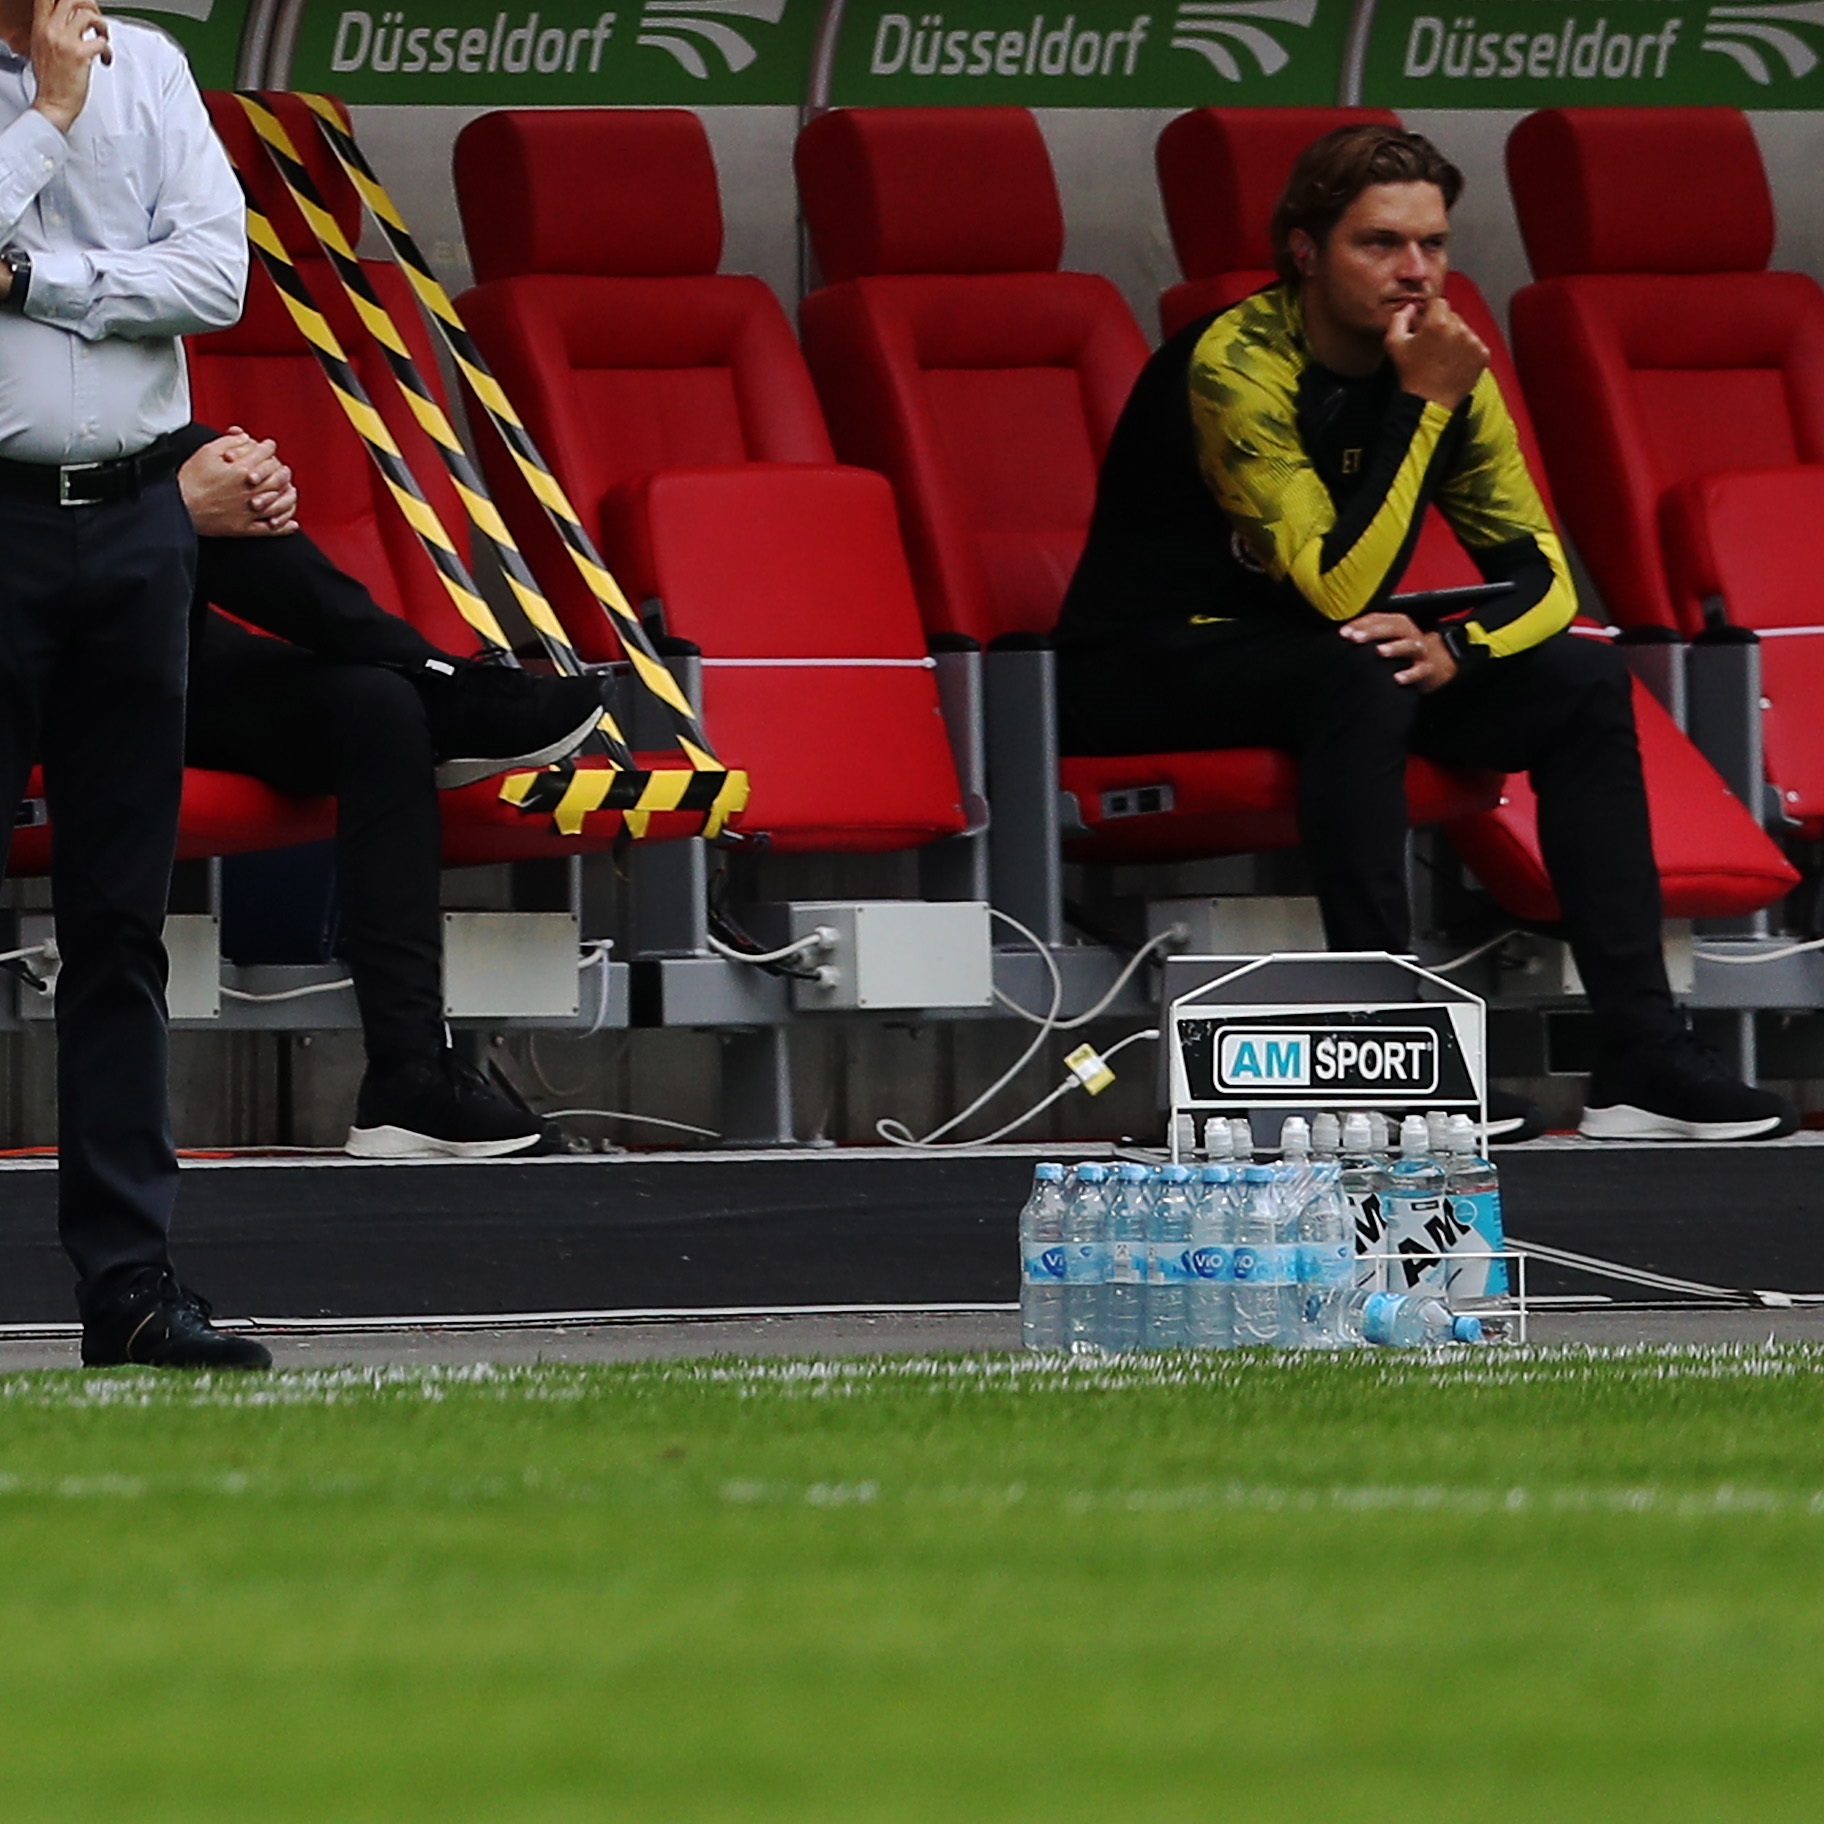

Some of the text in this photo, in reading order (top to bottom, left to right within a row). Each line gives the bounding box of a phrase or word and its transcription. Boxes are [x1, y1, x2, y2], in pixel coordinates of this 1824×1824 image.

[331, 10, 617, 74] Düsseldorf
[870, 14, 1152, 76] Düsseldorf
[1404, 16, 1683, 78] Düsseldorf
